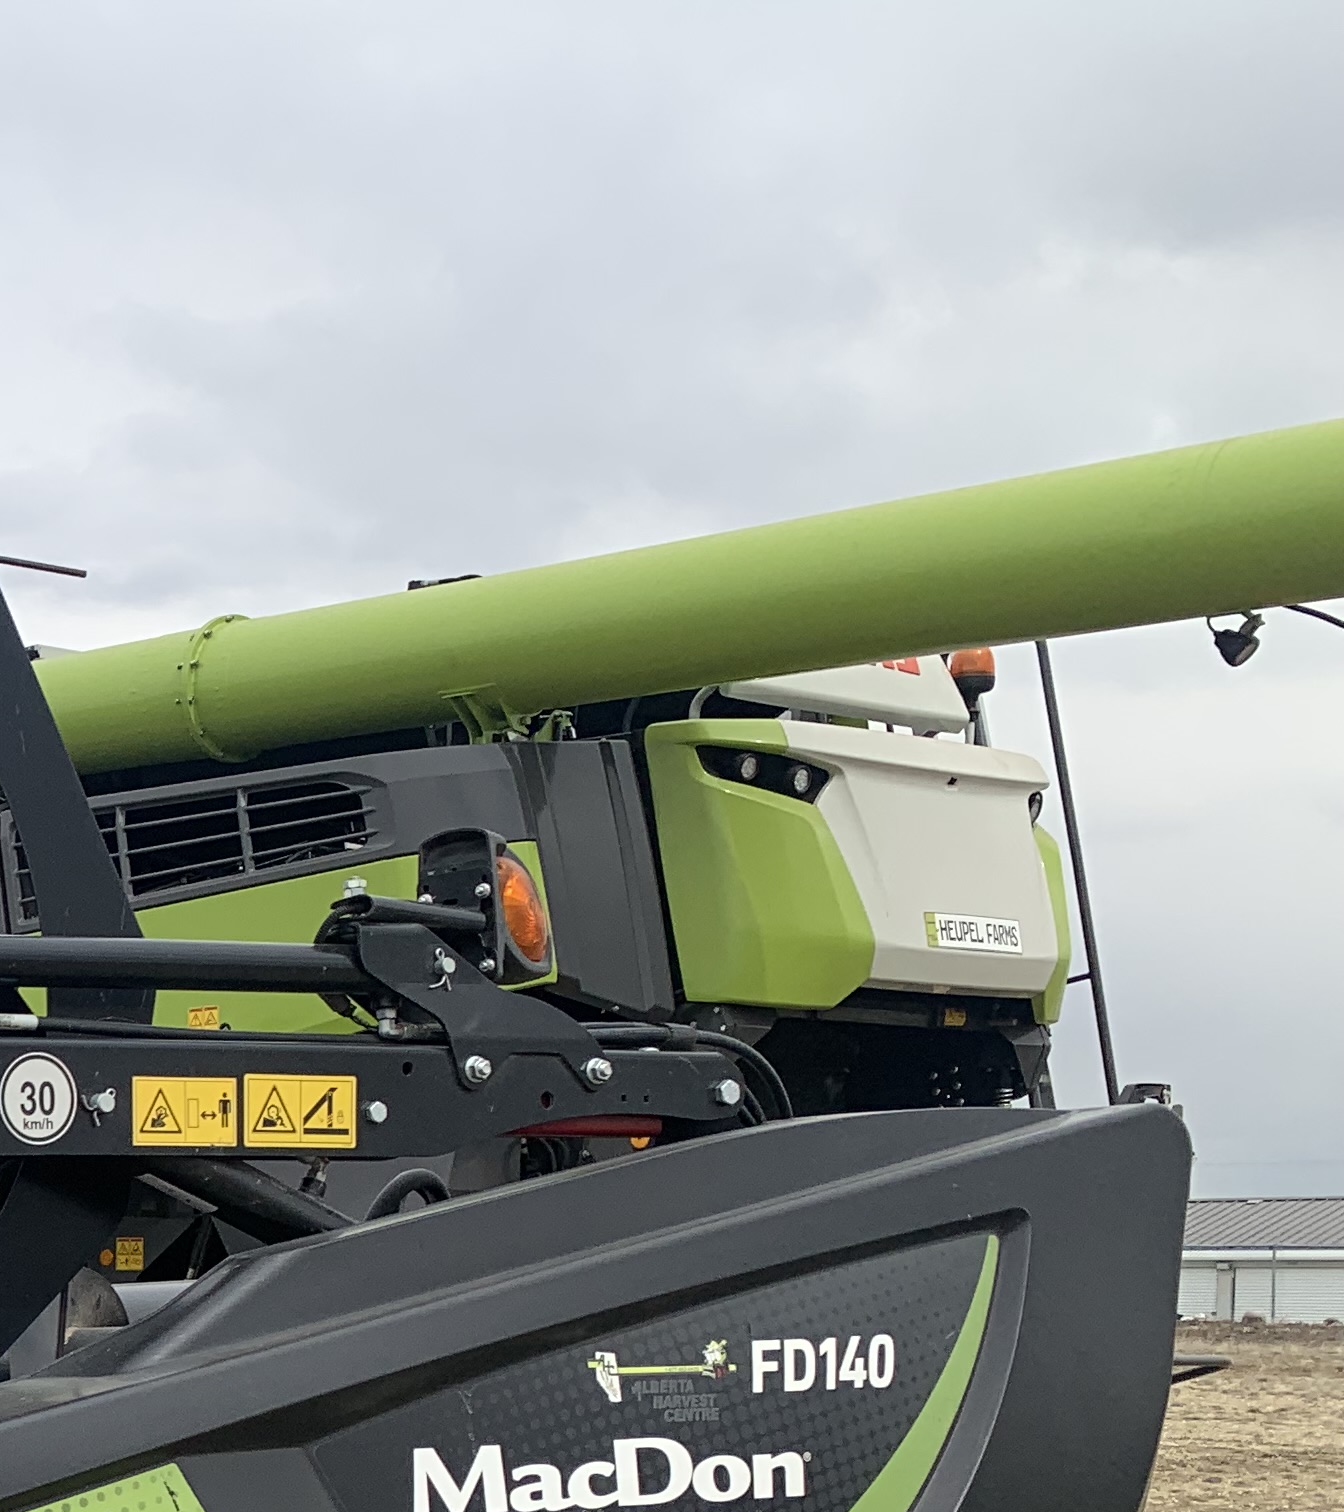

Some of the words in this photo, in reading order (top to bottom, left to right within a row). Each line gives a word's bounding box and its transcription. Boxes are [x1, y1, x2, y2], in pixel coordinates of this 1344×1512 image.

[939, 919, 984, 943] HEUPEL
[986, 923, 1019, 947] FARMS
[20, 1081, 55, 1116] 30
[23, 1118, 54, 1130] km/h
[752, 1334, 895, 1393] FD140
[653, 1394, 716, 1409] HARVEST
[663, 1408, 720, 1422] CENTRE
